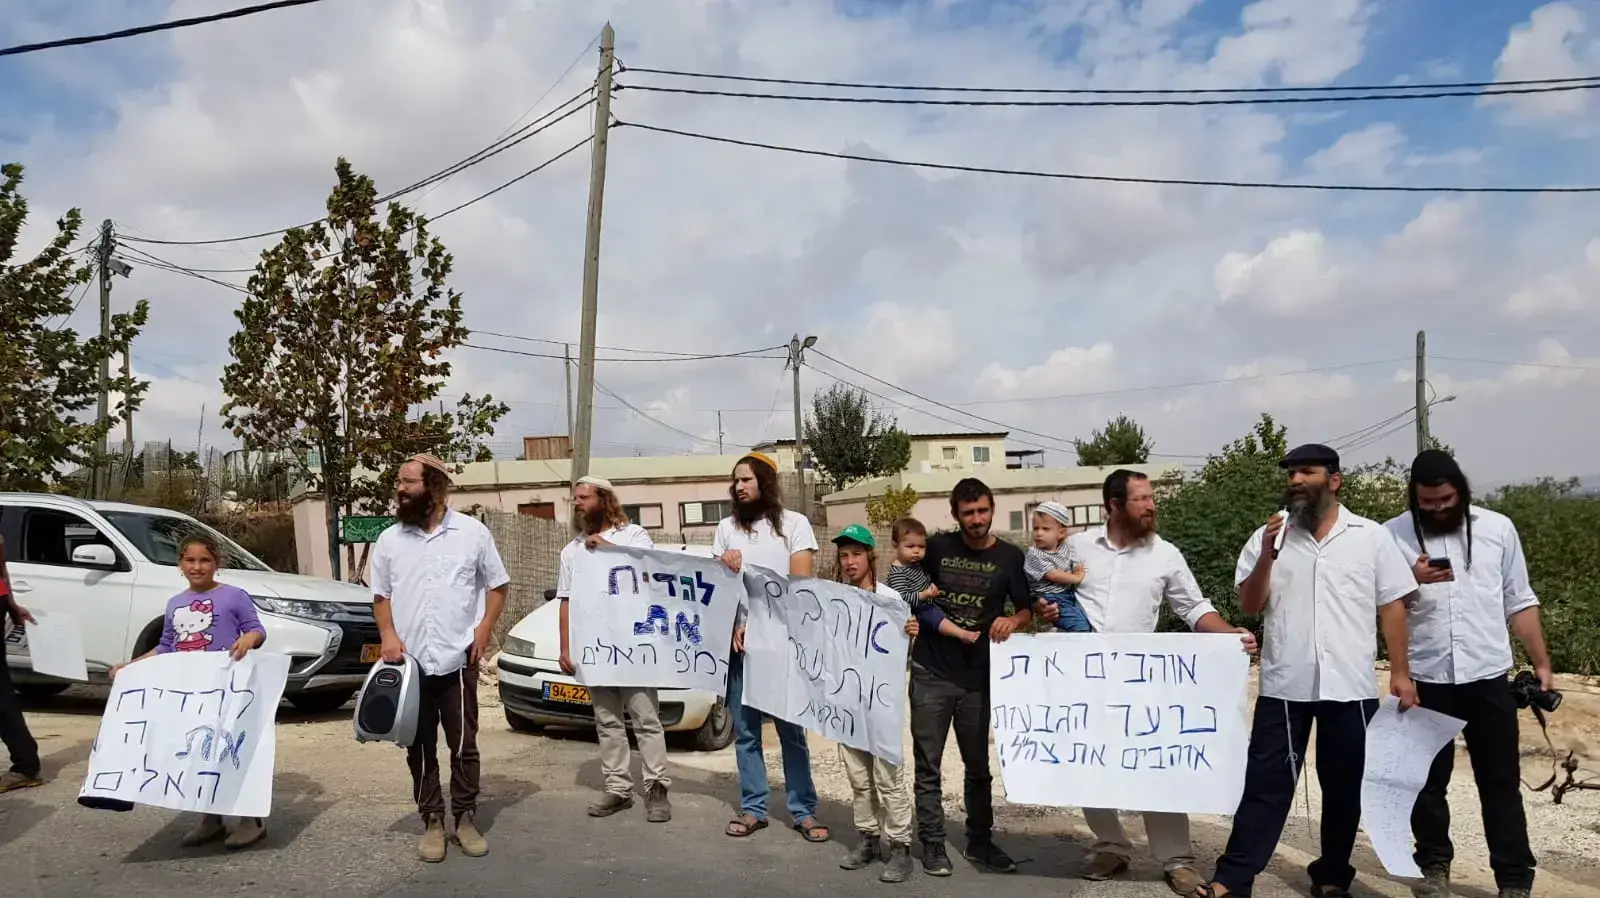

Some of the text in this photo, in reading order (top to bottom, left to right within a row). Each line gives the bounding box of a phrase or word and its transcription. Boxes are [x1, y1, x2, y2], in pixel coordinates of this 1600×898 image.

[941, 557, 981, 571] adidas
[608, 565, 716, 606] להדיח
[633, 604, 703, 646] את
[582, 637, 657, 666] האלים
[1000, 651, 1198, 685] אוהבים את
[116, 670, 255, 720] להדיח
[829, 667, 890, 711] את
[1068, 743, 1106, 767] את
[93, 753, 221, 805] האלים
